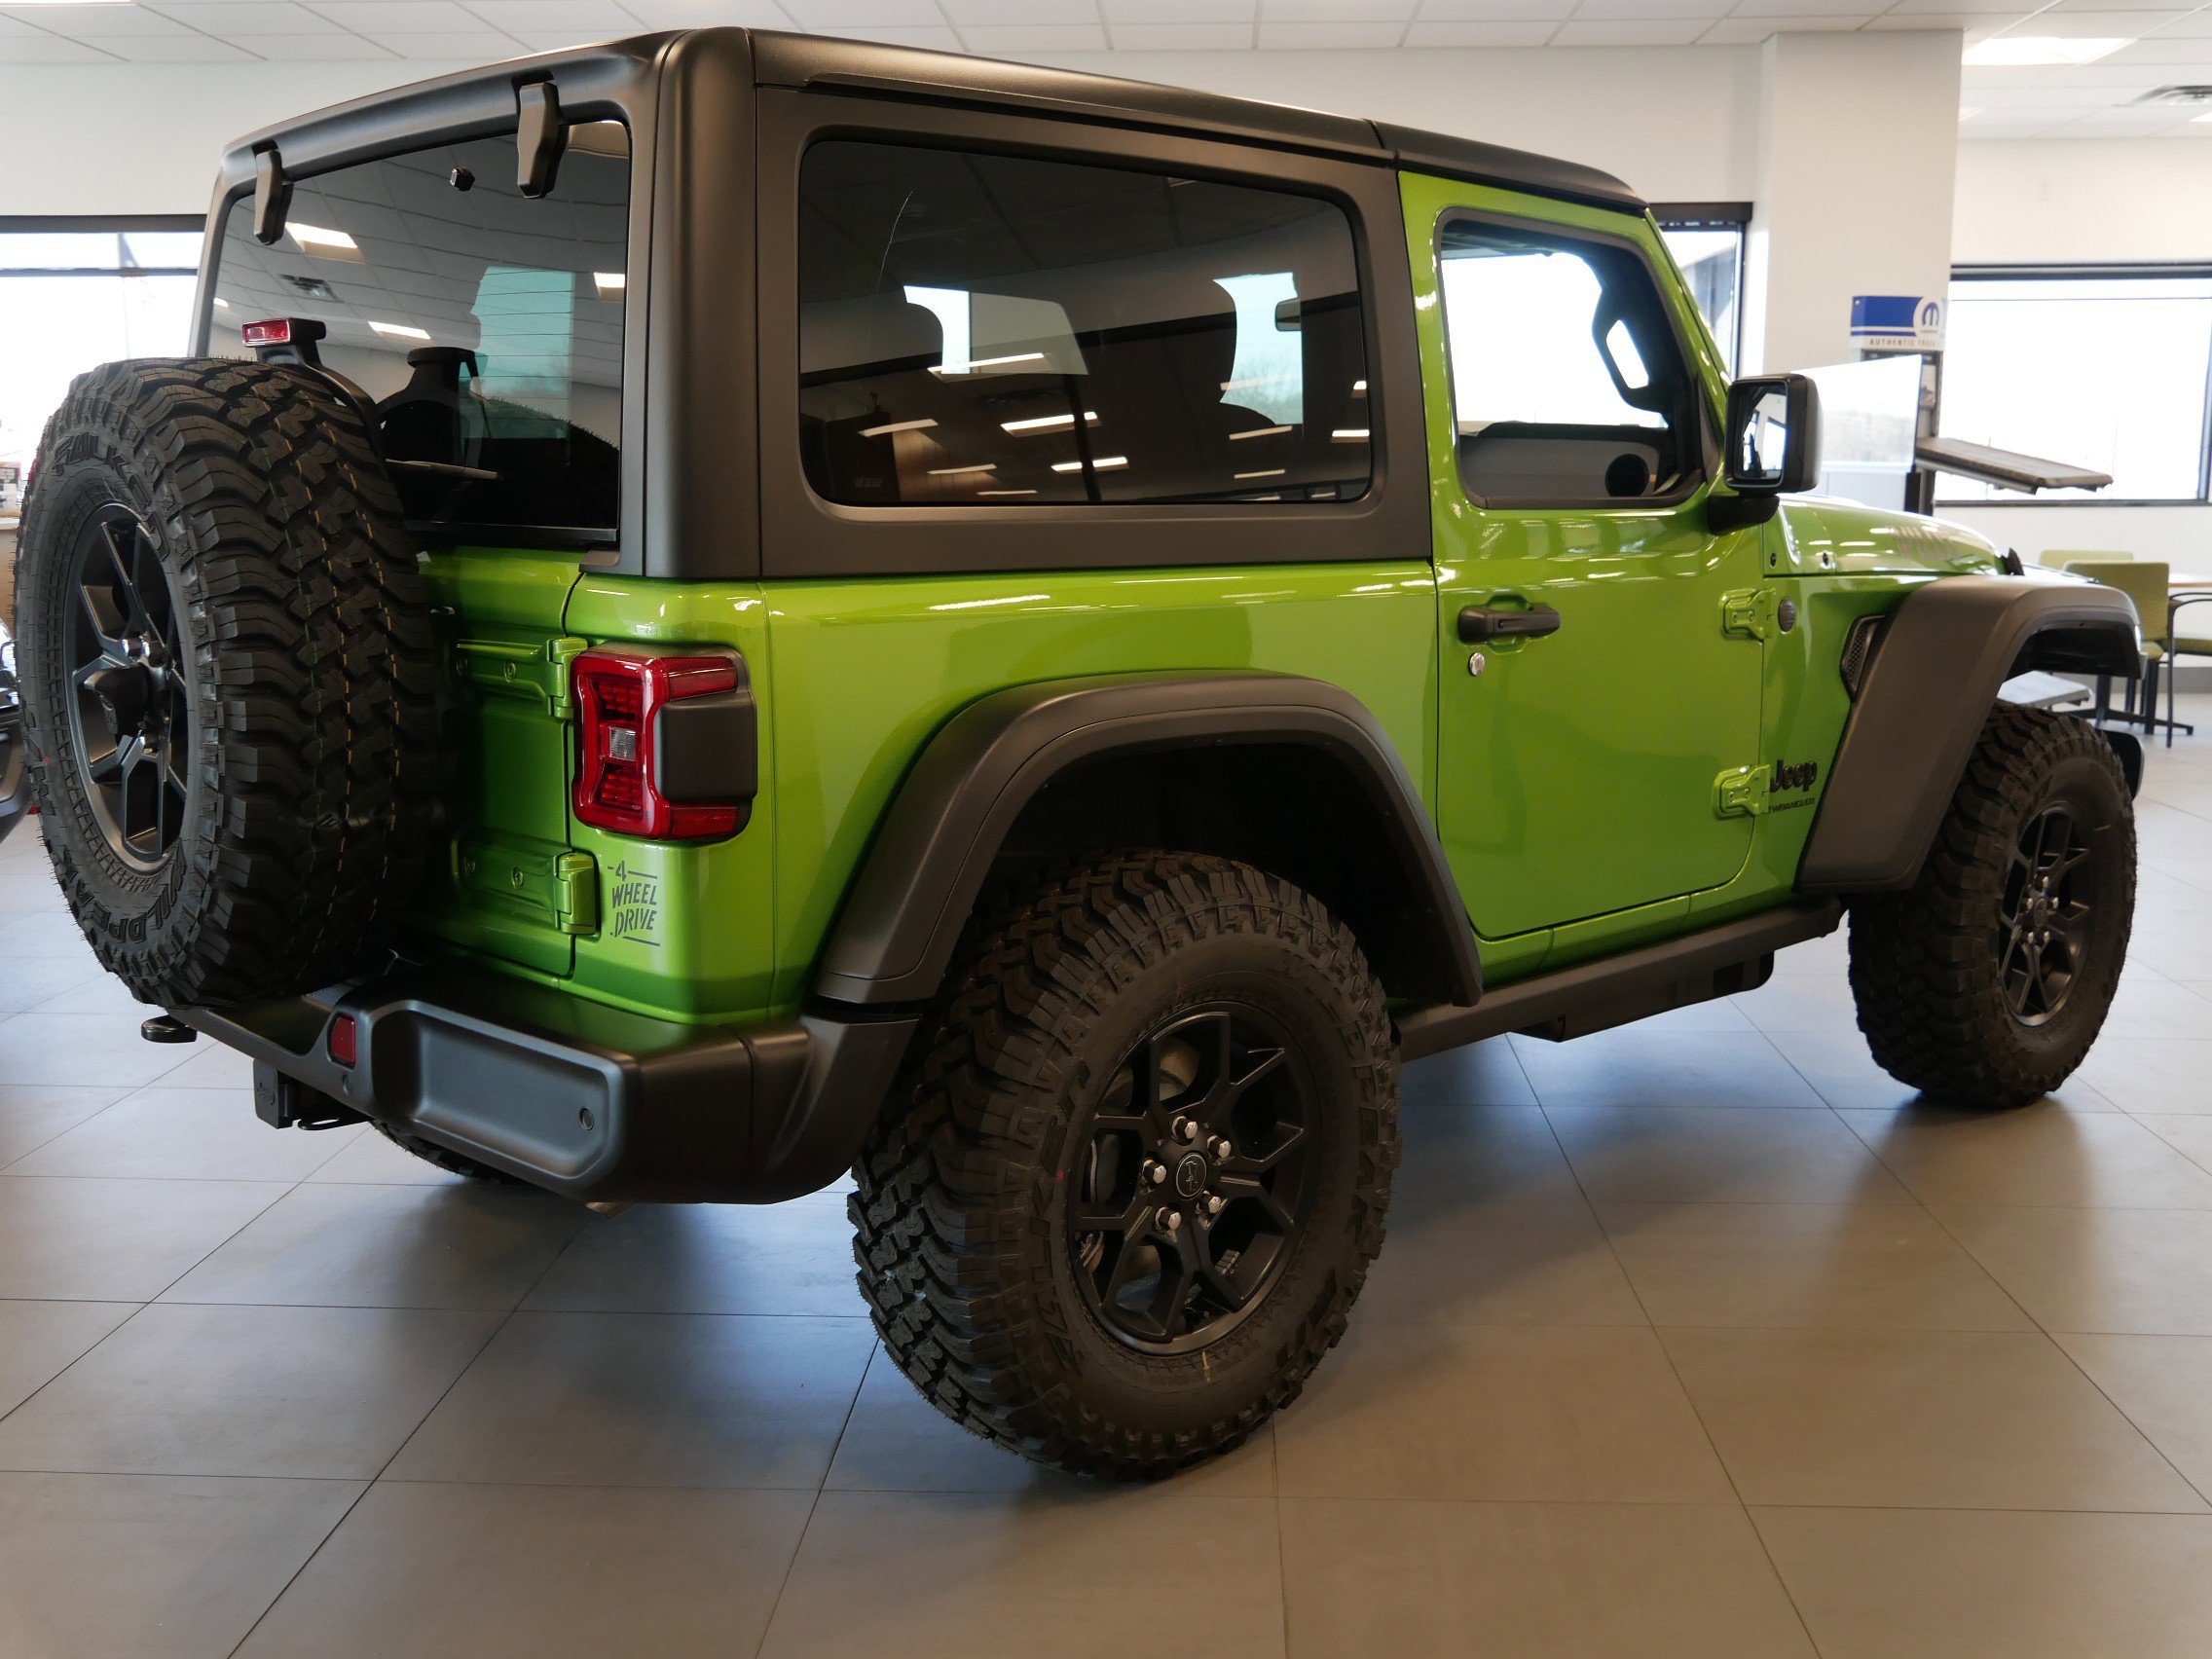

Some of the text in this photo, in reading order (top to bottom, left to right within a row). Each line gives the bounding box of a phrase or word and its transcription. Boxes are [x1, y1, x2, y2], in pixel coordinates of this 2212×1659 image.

[1869, 338, 1914, 347] AUTHENTIC
[1770, 759, 1818, 793] Jeep
[1772, 797, 1815, 813] WRANGLER
[615, 860, 627, 881] 4
[611, 882, 657, 908] WHEEL
[614, 907, 657, 938] DRIVE
